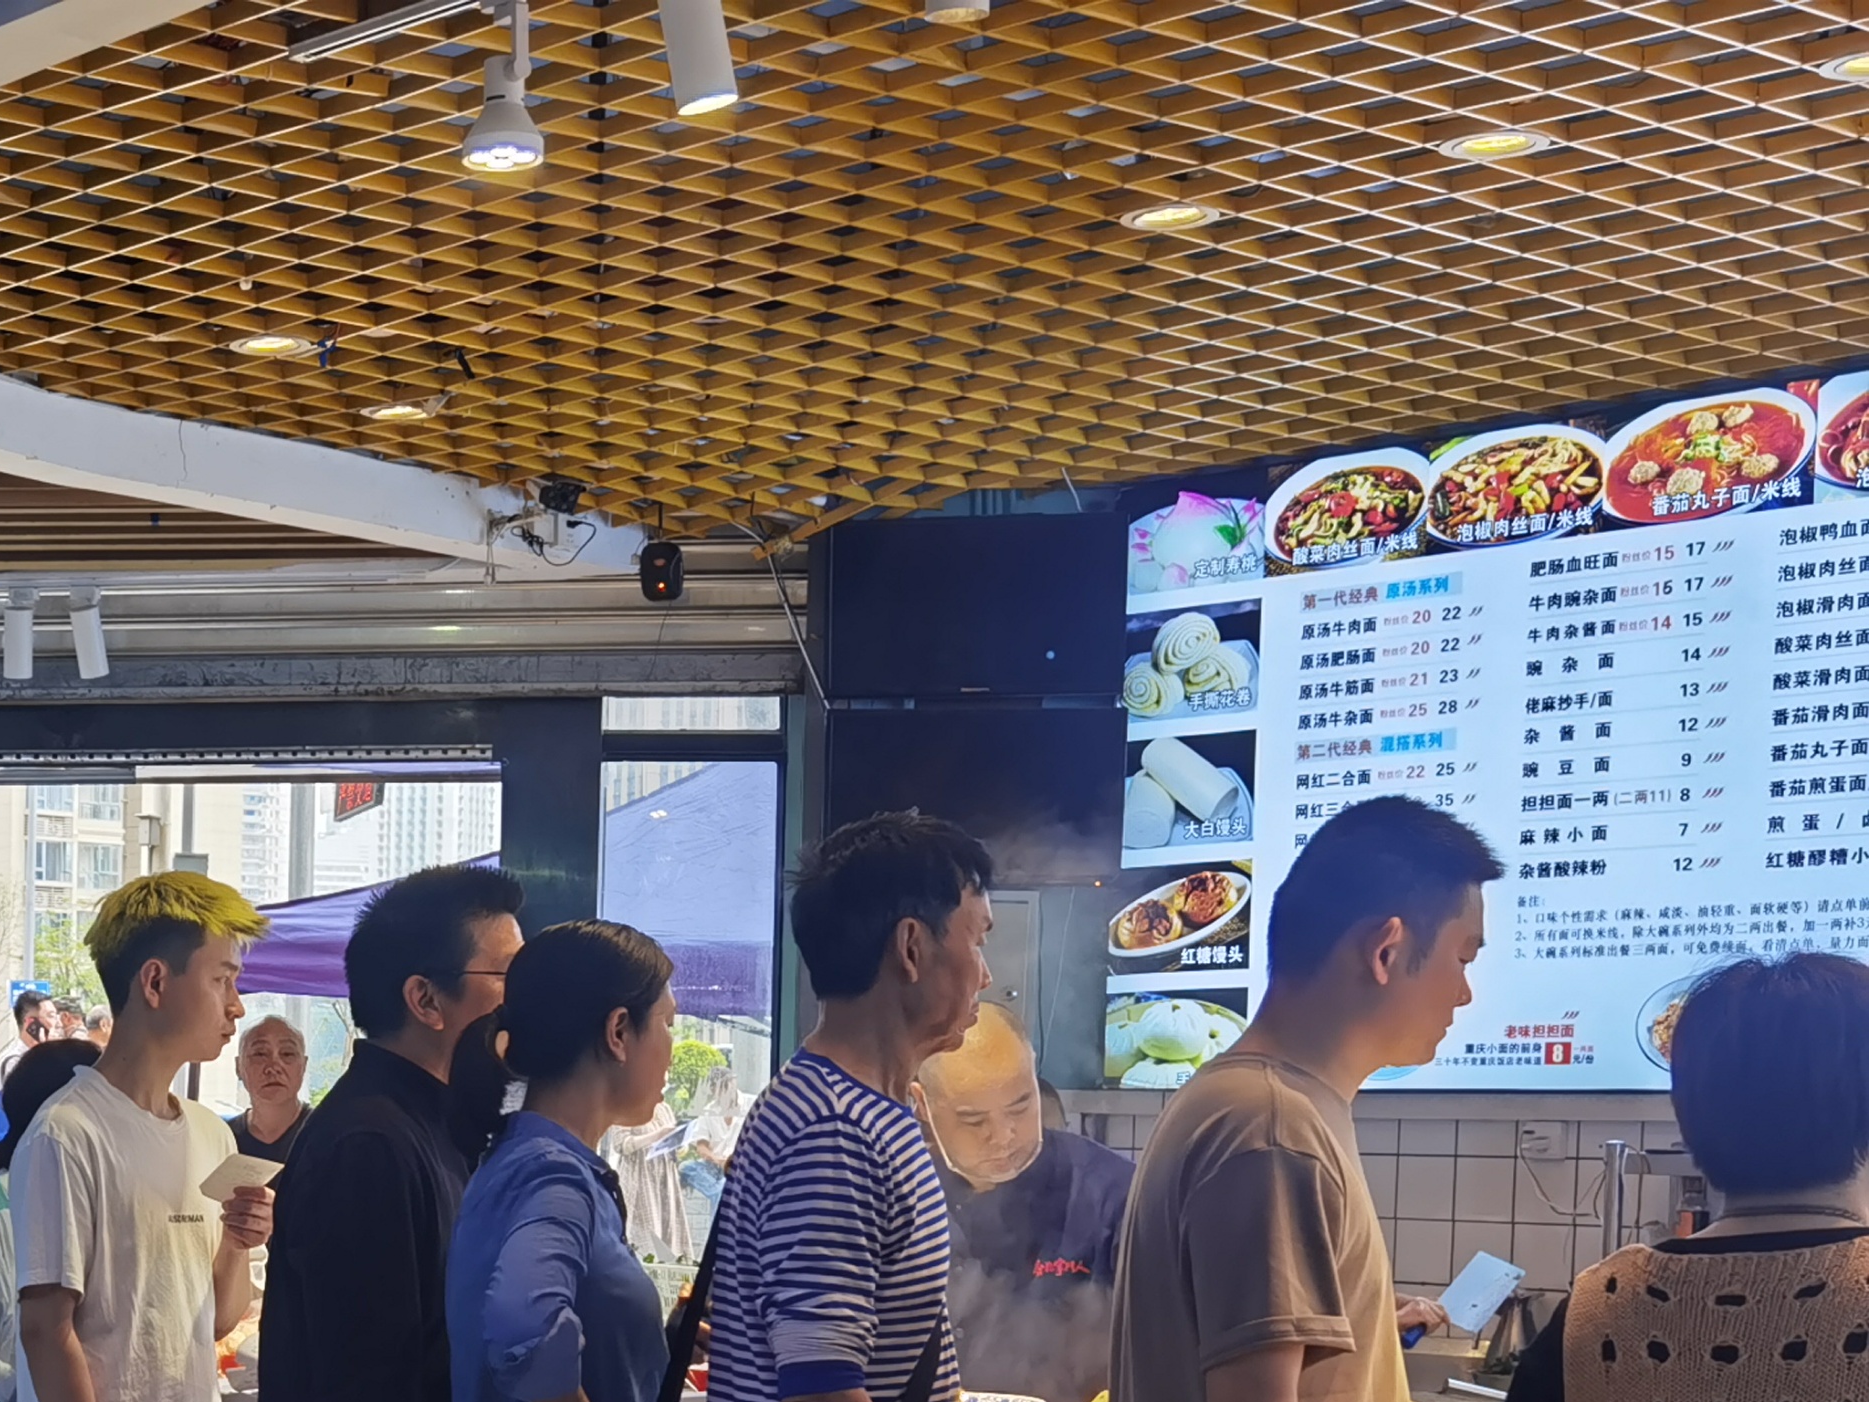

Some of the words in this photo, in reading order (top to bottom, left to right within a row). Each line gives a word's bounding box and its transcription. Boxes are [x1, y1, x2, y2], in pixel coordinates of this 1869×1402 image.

[1652, 478, 1801, 516] 番茄丸子面/米线
[1457, 507, 1593, 542] 泡椒肉丝面/米线
[1291, 532, 1419, 566] 酸菜肉丝面/米线
[1530, 552, 1618, 577] 肥肠血旺面
[1655, 545, 1675, 561] 15
[1686, 542, 1705, 557] 17
[1194, 553, 1256, 579] 定制寿桃
[1301, 586, 1378, 610] 第一代经典
[1386, 576, 1449, 599] 原汤系列
[1529, 587, 1617, 611] 牛肉豌杂面
[1684, 576, 1704, 592] 17
[1301, 617, 1377, 640] 原汤牛肉面
[1412, 610, 1431, 624] 20
[1442, 606, 1461, 621] 22
[1528, 618, 1616, 642] 牛肉杂酱面
[1651, 616, 1672, 631] 14
[1683, 612, 1703, 627] 15
[1300, 648, 1376, 670] 原汤肥肠面
[1411, 641, 1430, 655] 20
[1440, 638, 1460, 652] 22
[1526, 653, 1615, 676] 豌杂面
[1681, 648, 1701, 662] 14
[1299, 678, 1375, 700] 原汤牛筋面
[1409, 672, 1428, 686] 21
[1440, 669, 1459, 683] 23
[1680, 683, 1700, 697] 13
[1188, 688, 1251, 711] 手撕花卷
[1298, 709, 1374, 730] 原汤牛杂面
[1408, 703, 1427, 717] 25
[1438, 700, 1457, 714] 28
[1772, 701, 1869, 726] 番茄滑肉面
[1524, 722, 1612, 745] 杂酱面
[1679, 718, 1698, 732] 12
[1297, 738, 1373, 760] 第二代经典
[1380, 732, 1443, 751] 混搭系列
[1770, 738, 1869, 762] 番茄丸子面
[1296, 769, 1371, 790] 网红二合面
[1406, 765, 1425, 779] 22
[1436, 762, 1455, 776] 25
[1523, 756, 1611, 778] 豌豆面
[1681, 753, 1691, 767] 9
[1769, 774, 1867, 798] 番茄煎蛋面
[1435, 793, 1454, 807] 35
[1521, 790, 1609, 813] 担担面一两
[1680, 788, 1690, 801] 8
[1185, 817, 1246, 838] 大白馒头
[1519, 825, 1608, 846] 麻辣小面
[1679, 823, 1688, 837] 7
[1519, 860, 1607, 879] 杂酱酸辣粉
[1673, 857, 1693, 871] 12
[1180, 945, 1243, 965] 红糖馒头
[1504, 1024, 1574, 1039] 老味担担面
[1552, 1044, 1563, 1062] 8
